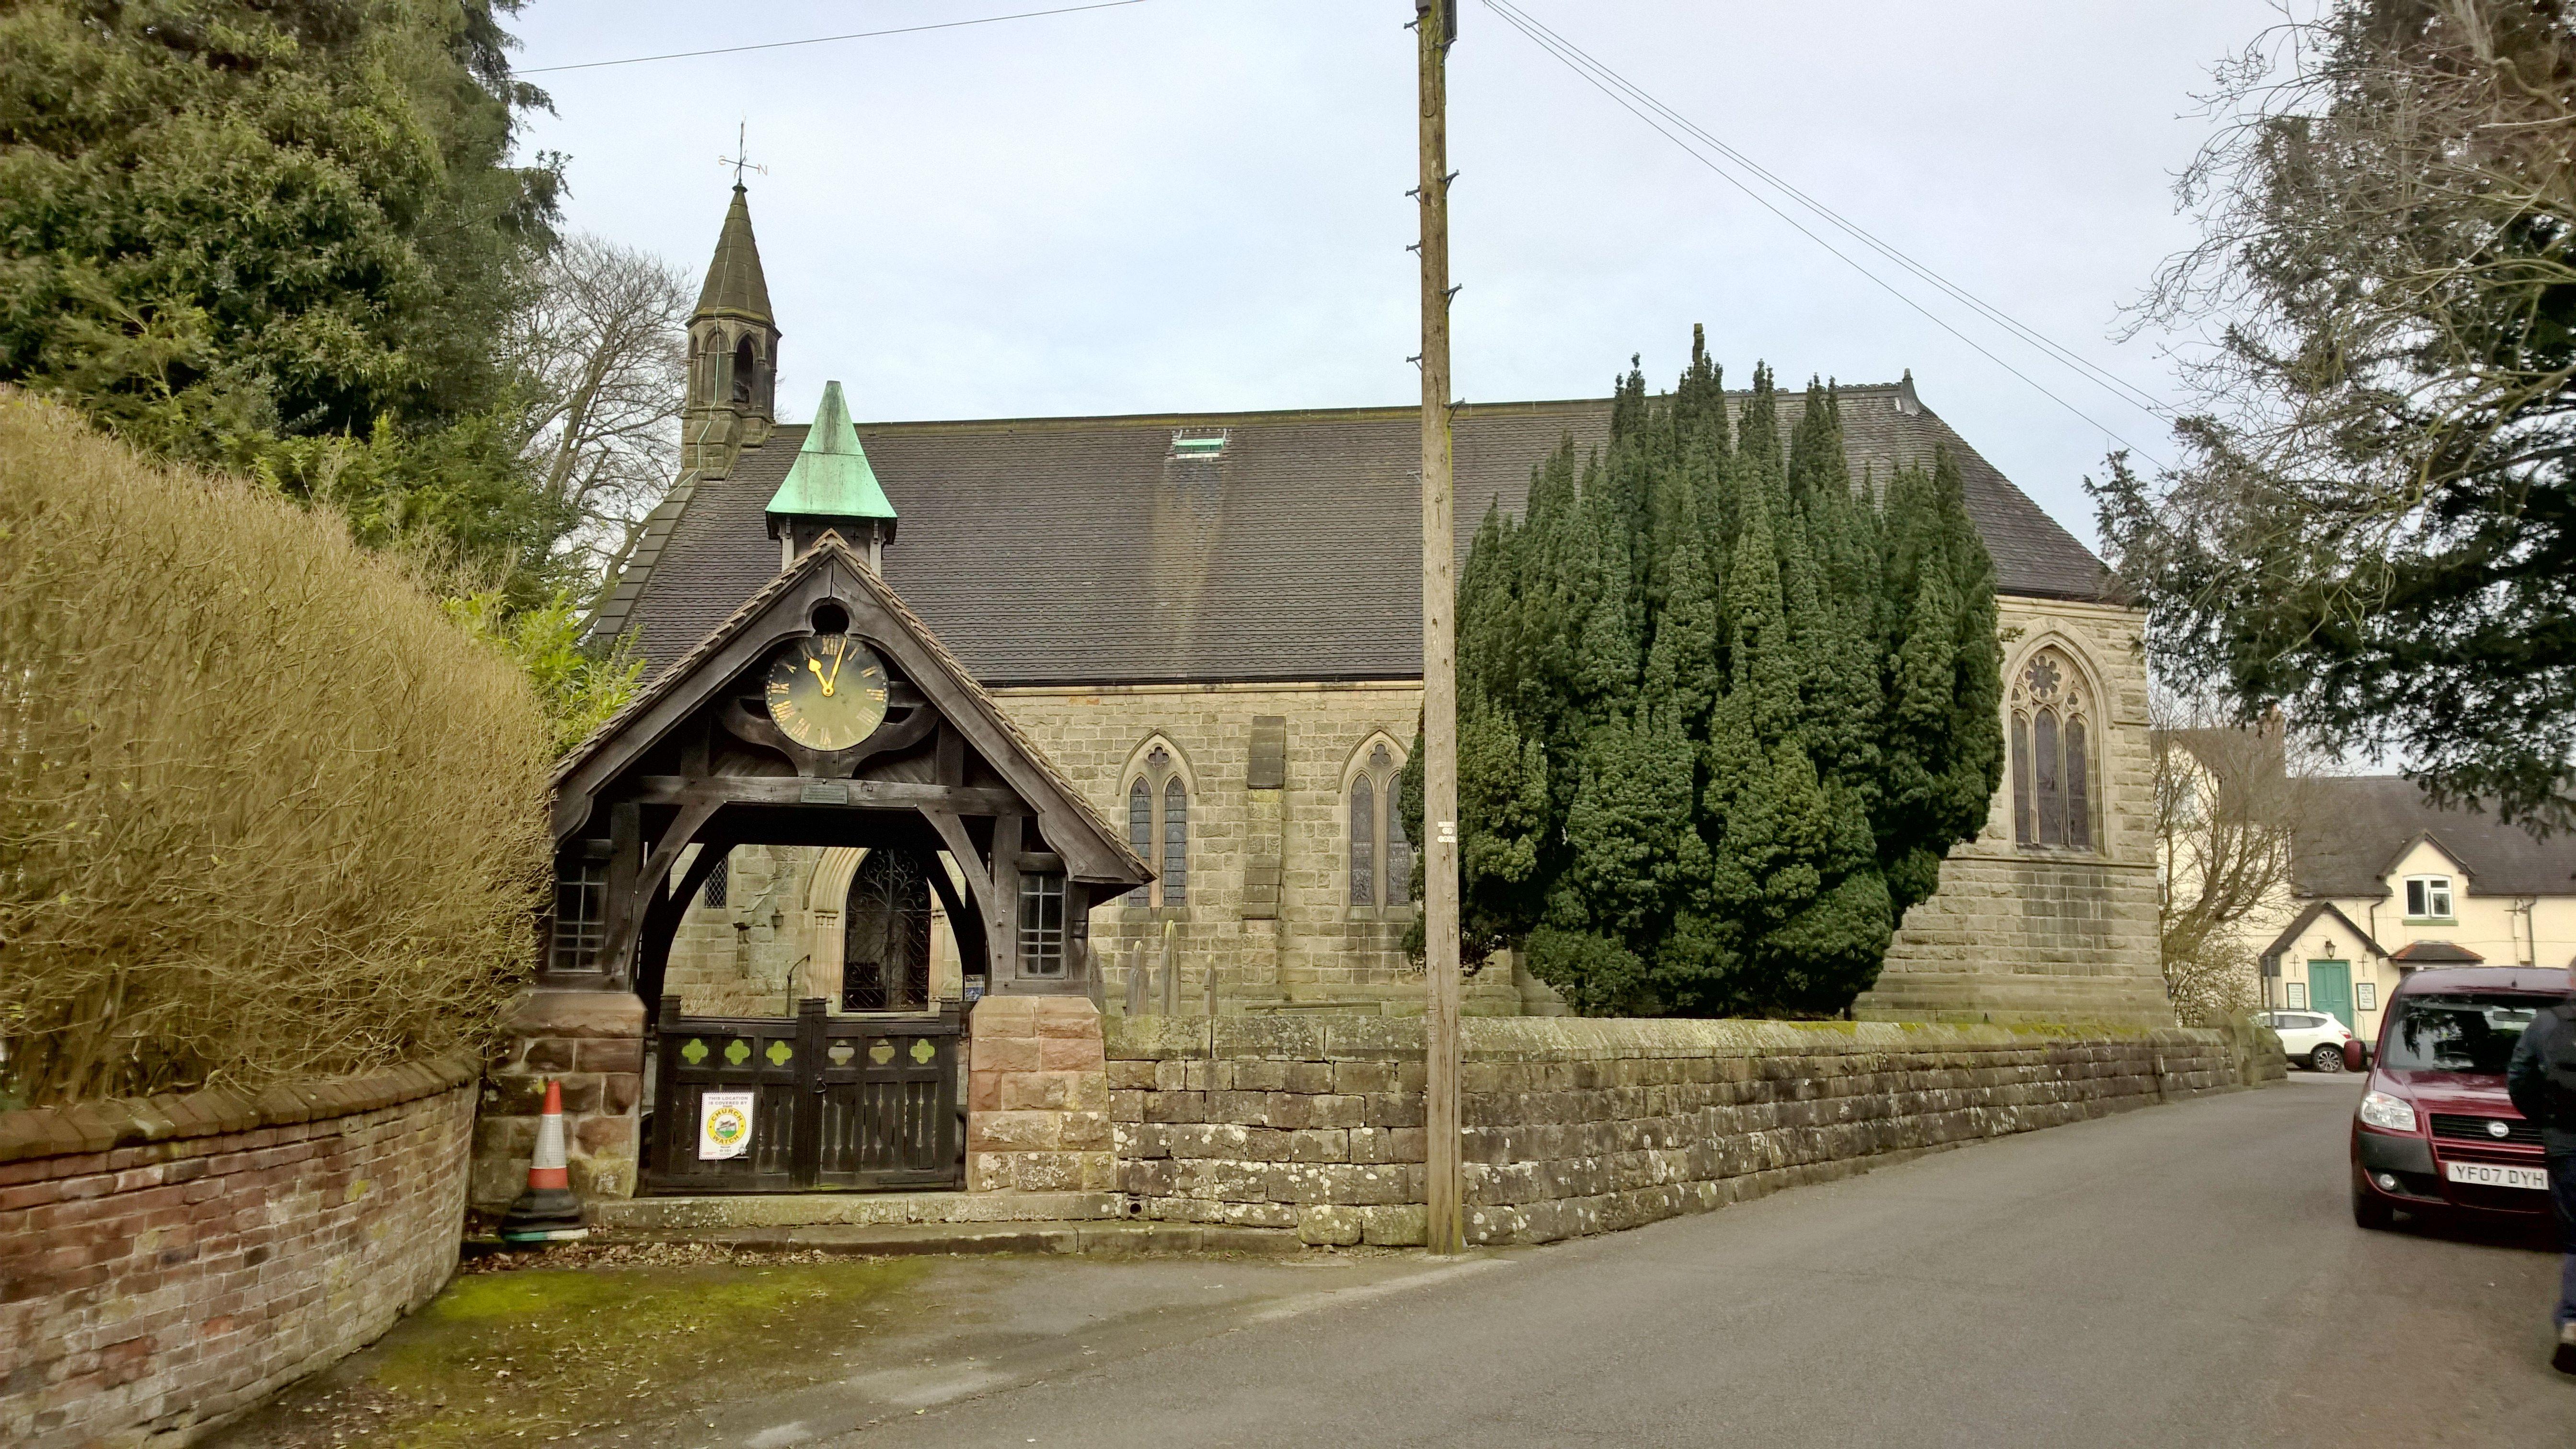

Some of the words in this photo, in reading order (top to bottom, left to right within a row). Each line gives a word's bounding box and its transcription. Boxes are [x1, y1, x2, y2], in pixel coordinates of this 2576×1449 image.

[821, 637, 838, 655] XII
[861, 666, 878, 678] II
[770, 681, 790, 695] IX
[866, 688, 884, 702] III
[773, 700, 796, 722] VIII
[791, 718, 811, 739] VII
[820, 727, 832, 746] VI
[711, 1109, 743, 1122] CHURCH
[713, 1135, 739, 1145] WATCH
[2456, 1165, 2502, 1183] YF07
[2508, 1170, 2544, 1187] DYH
